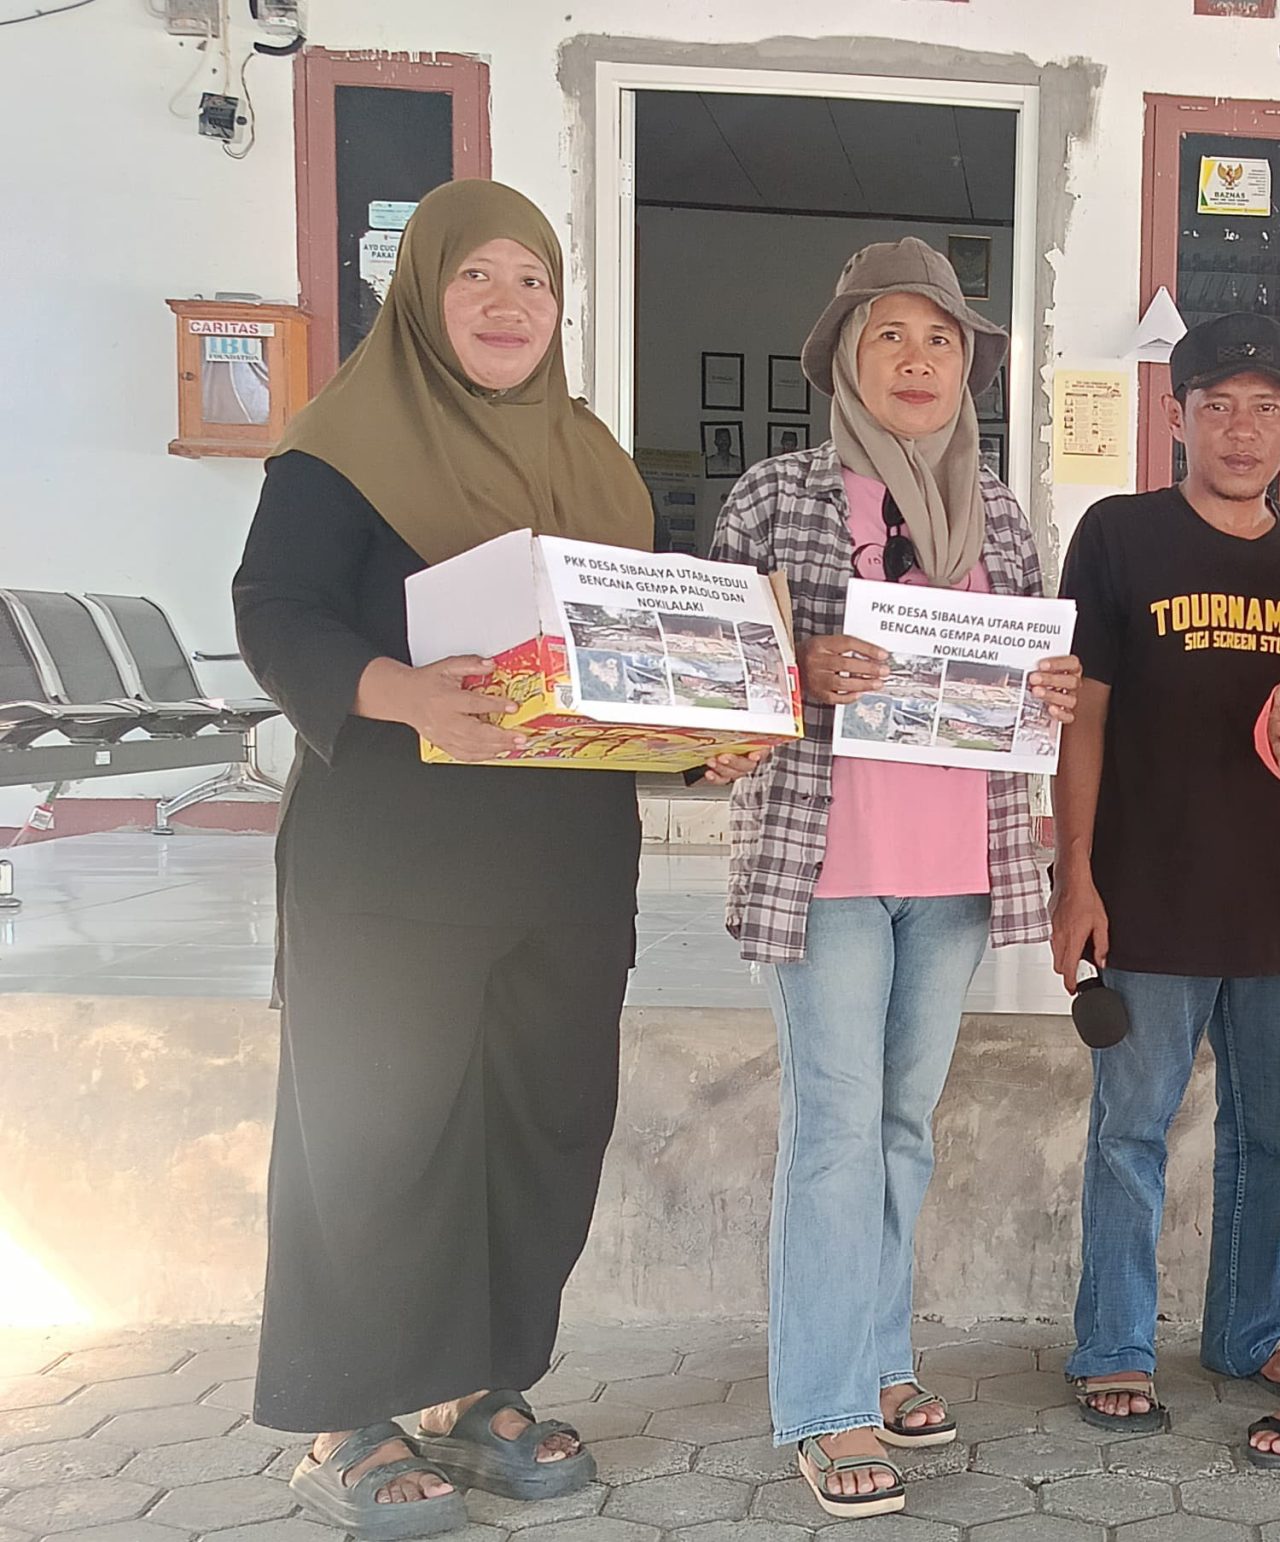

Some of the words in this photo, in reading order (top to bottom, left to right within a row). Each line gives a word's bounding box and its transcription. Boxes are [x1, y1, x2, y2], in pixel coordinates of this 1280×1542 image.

[190, 321, 259, 334] CARITAS
[209, 336, 259, 355] IBU
[209, 353, 259, 361] FOUNDATION
[564, 555, 587, 568] PKK
[590, 558, 619, 573] DESA
[620, 563, 675, 579] SIBALAYA
[677, 568, 711, 583] UTARA
[712, 575, 748, 590] PEDULI
[579, 574, 634, 591] BENCANA
[636, 581, 678, 595] GEMPA
[681, 584, 720, 600] PALOLO
[721, 591, 745, 603] DAN
[637, 597, 704, 612] NOKILALAKI
[871, 602, 895, 614] PKK
[897, 605, 928, 619] DESA
[931, 610, 984, 627] SIBALAYA
[987, 618, 1024, 631] UTARA
[1026, 622, 1061, 635] PEDULI
[880, 620, 937, 638] BENCANA
[939, 629, 980, 643] GEMPA
[983, 634, 1026, 648] PALOLO
[1028, 638, 1051, 651] DAN
[1184, 630, 1210, 651] SIGI
[1213, 630, 1257, 651] SCREEN
[933, 644, 999, 661] NOKILALAKI
